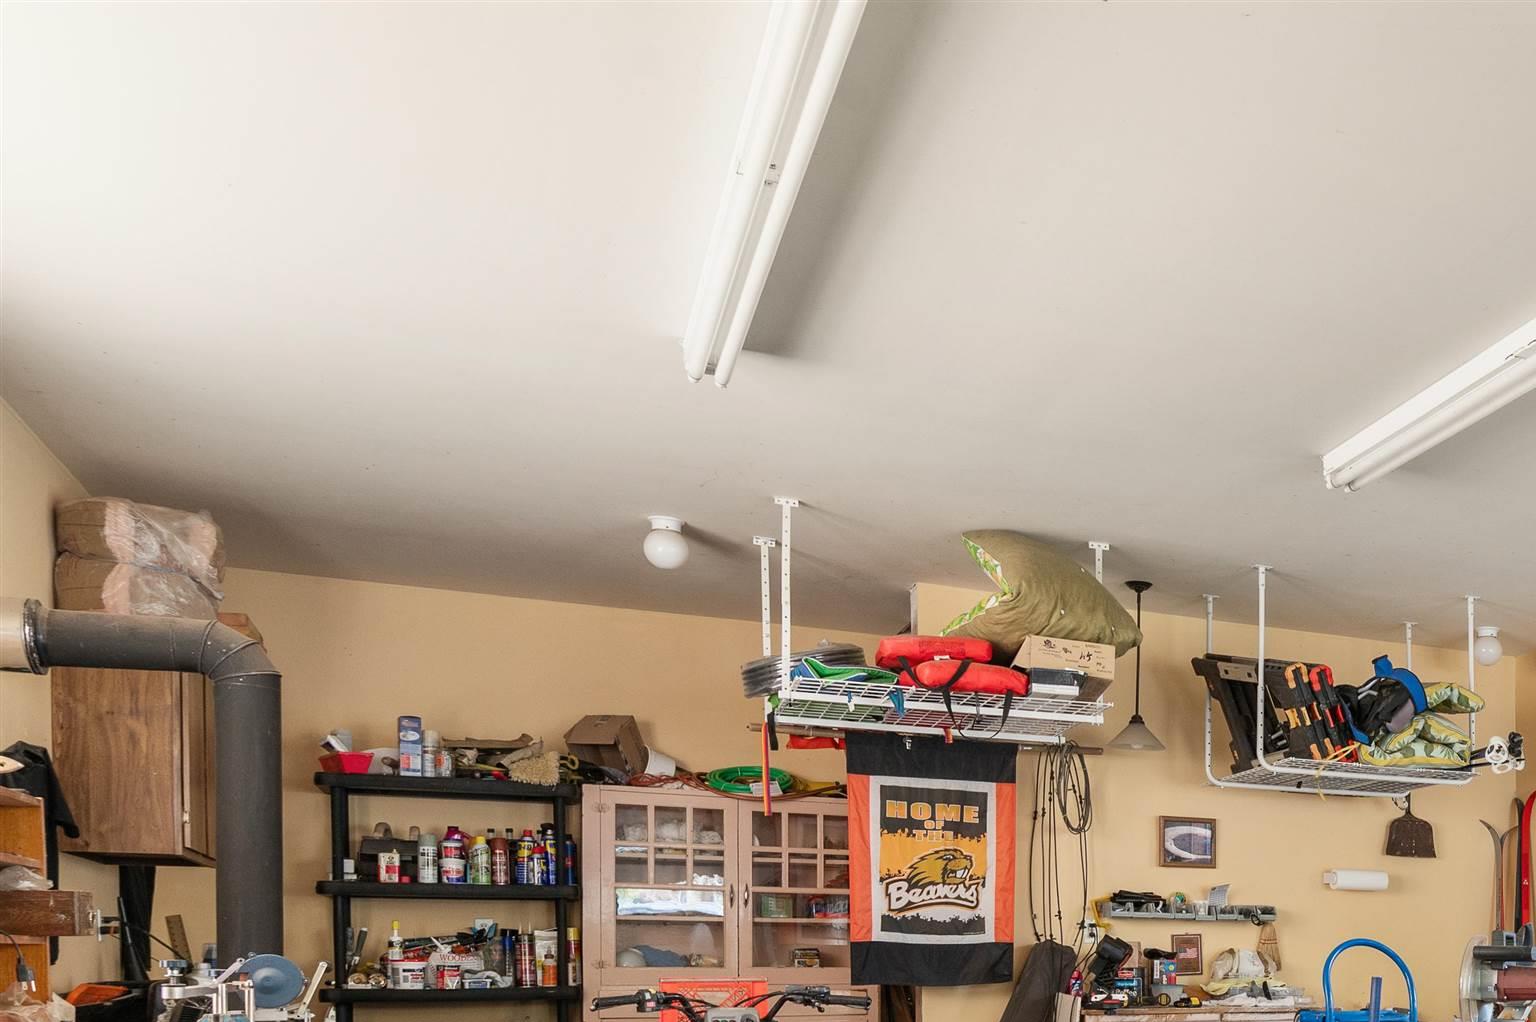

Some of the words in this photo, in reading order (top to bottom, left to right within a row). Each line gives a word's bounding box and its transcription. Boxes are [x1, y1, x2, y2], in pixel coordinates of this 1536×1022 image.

[885, 799, 979, 823] HOME
[924, 819, 944, 830] OF
[913, 829, 954, 842] THE
[886, 881, 977, 909] Beavers
